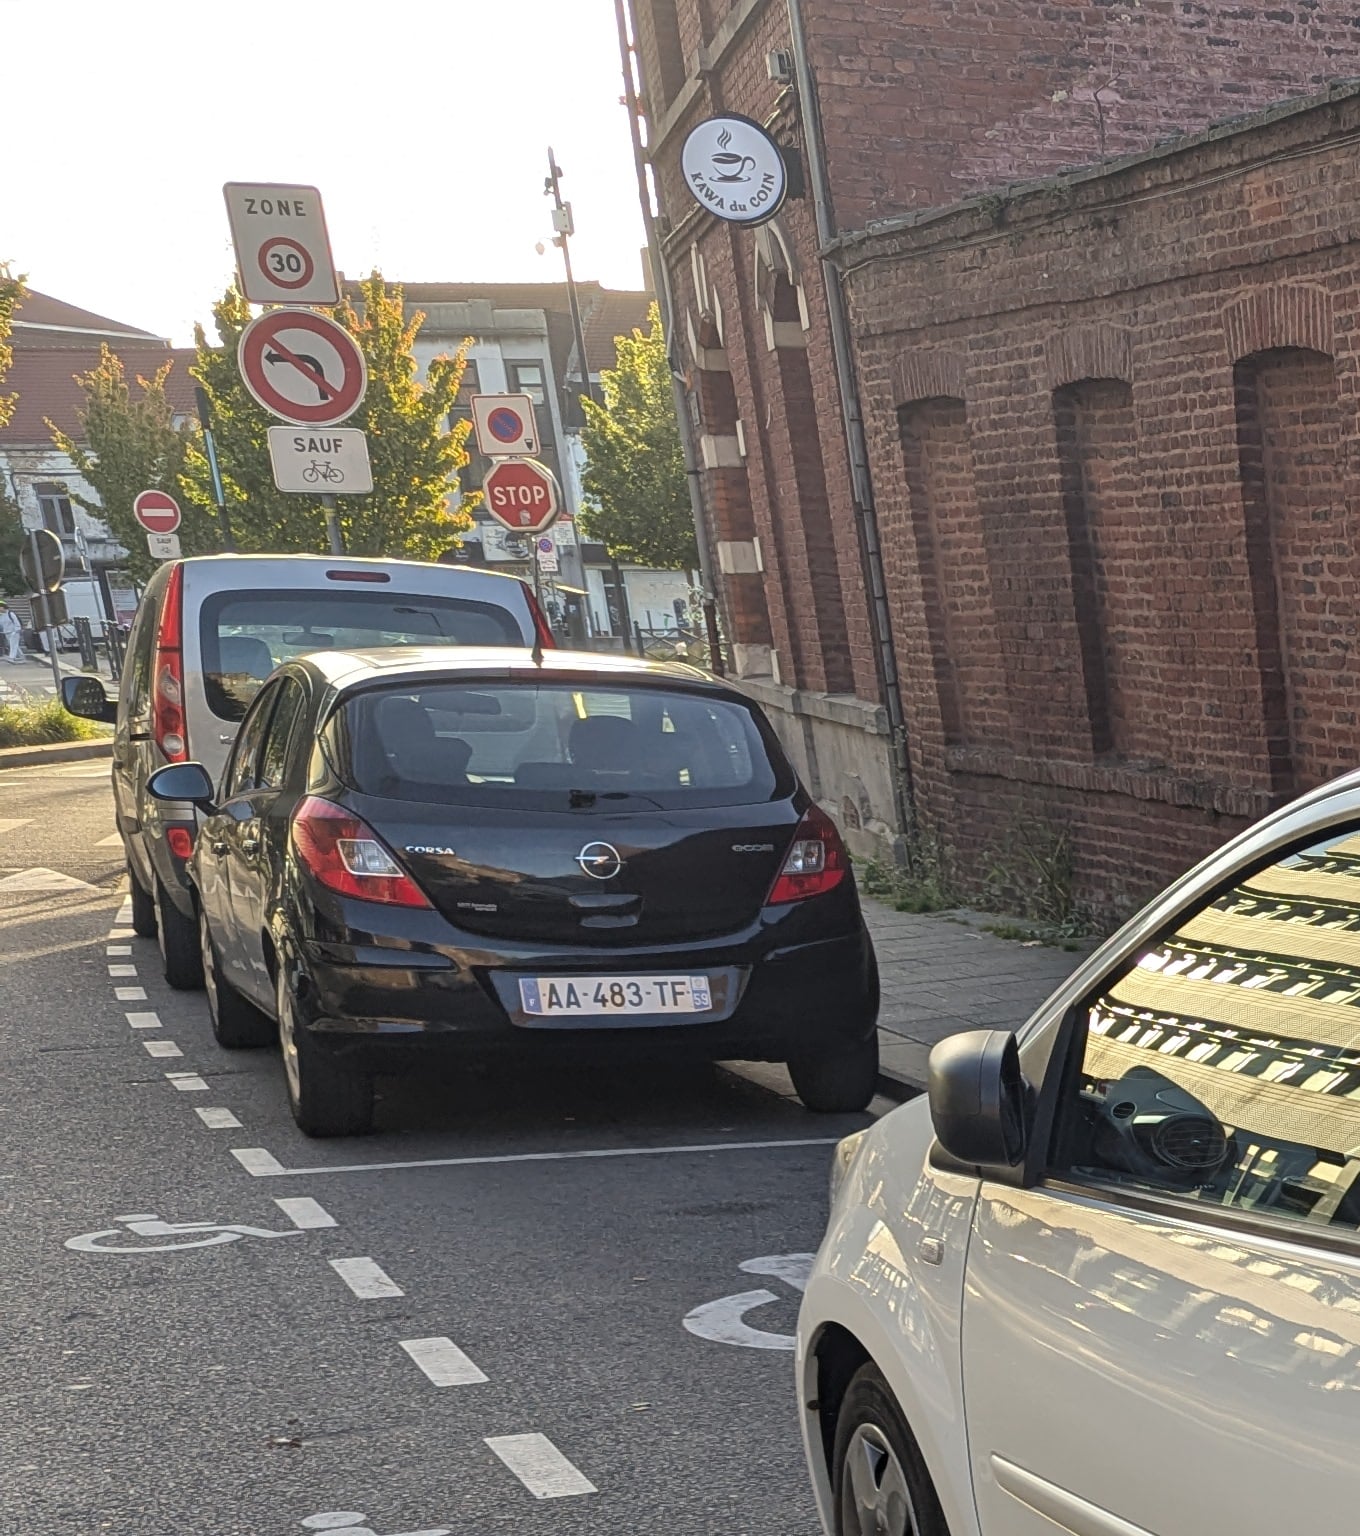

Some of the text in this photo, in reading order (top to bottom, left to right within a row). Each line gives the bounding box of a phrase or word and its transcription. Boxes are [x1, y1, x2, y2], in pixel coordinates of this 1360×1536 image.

[690, 171, 776, 212] KAWA du COIN
[244, 198, 306, 217] ZONE
[270, 253, 301, 273] 30
[293, 437, 343, 453] SAUF
[493, 484, 545, 506] STOP
[405, 845, 455, 855] CORSA
[547, 981, 687, 1009] AA-483-TF
[694, 993, 709, 1007] 59
